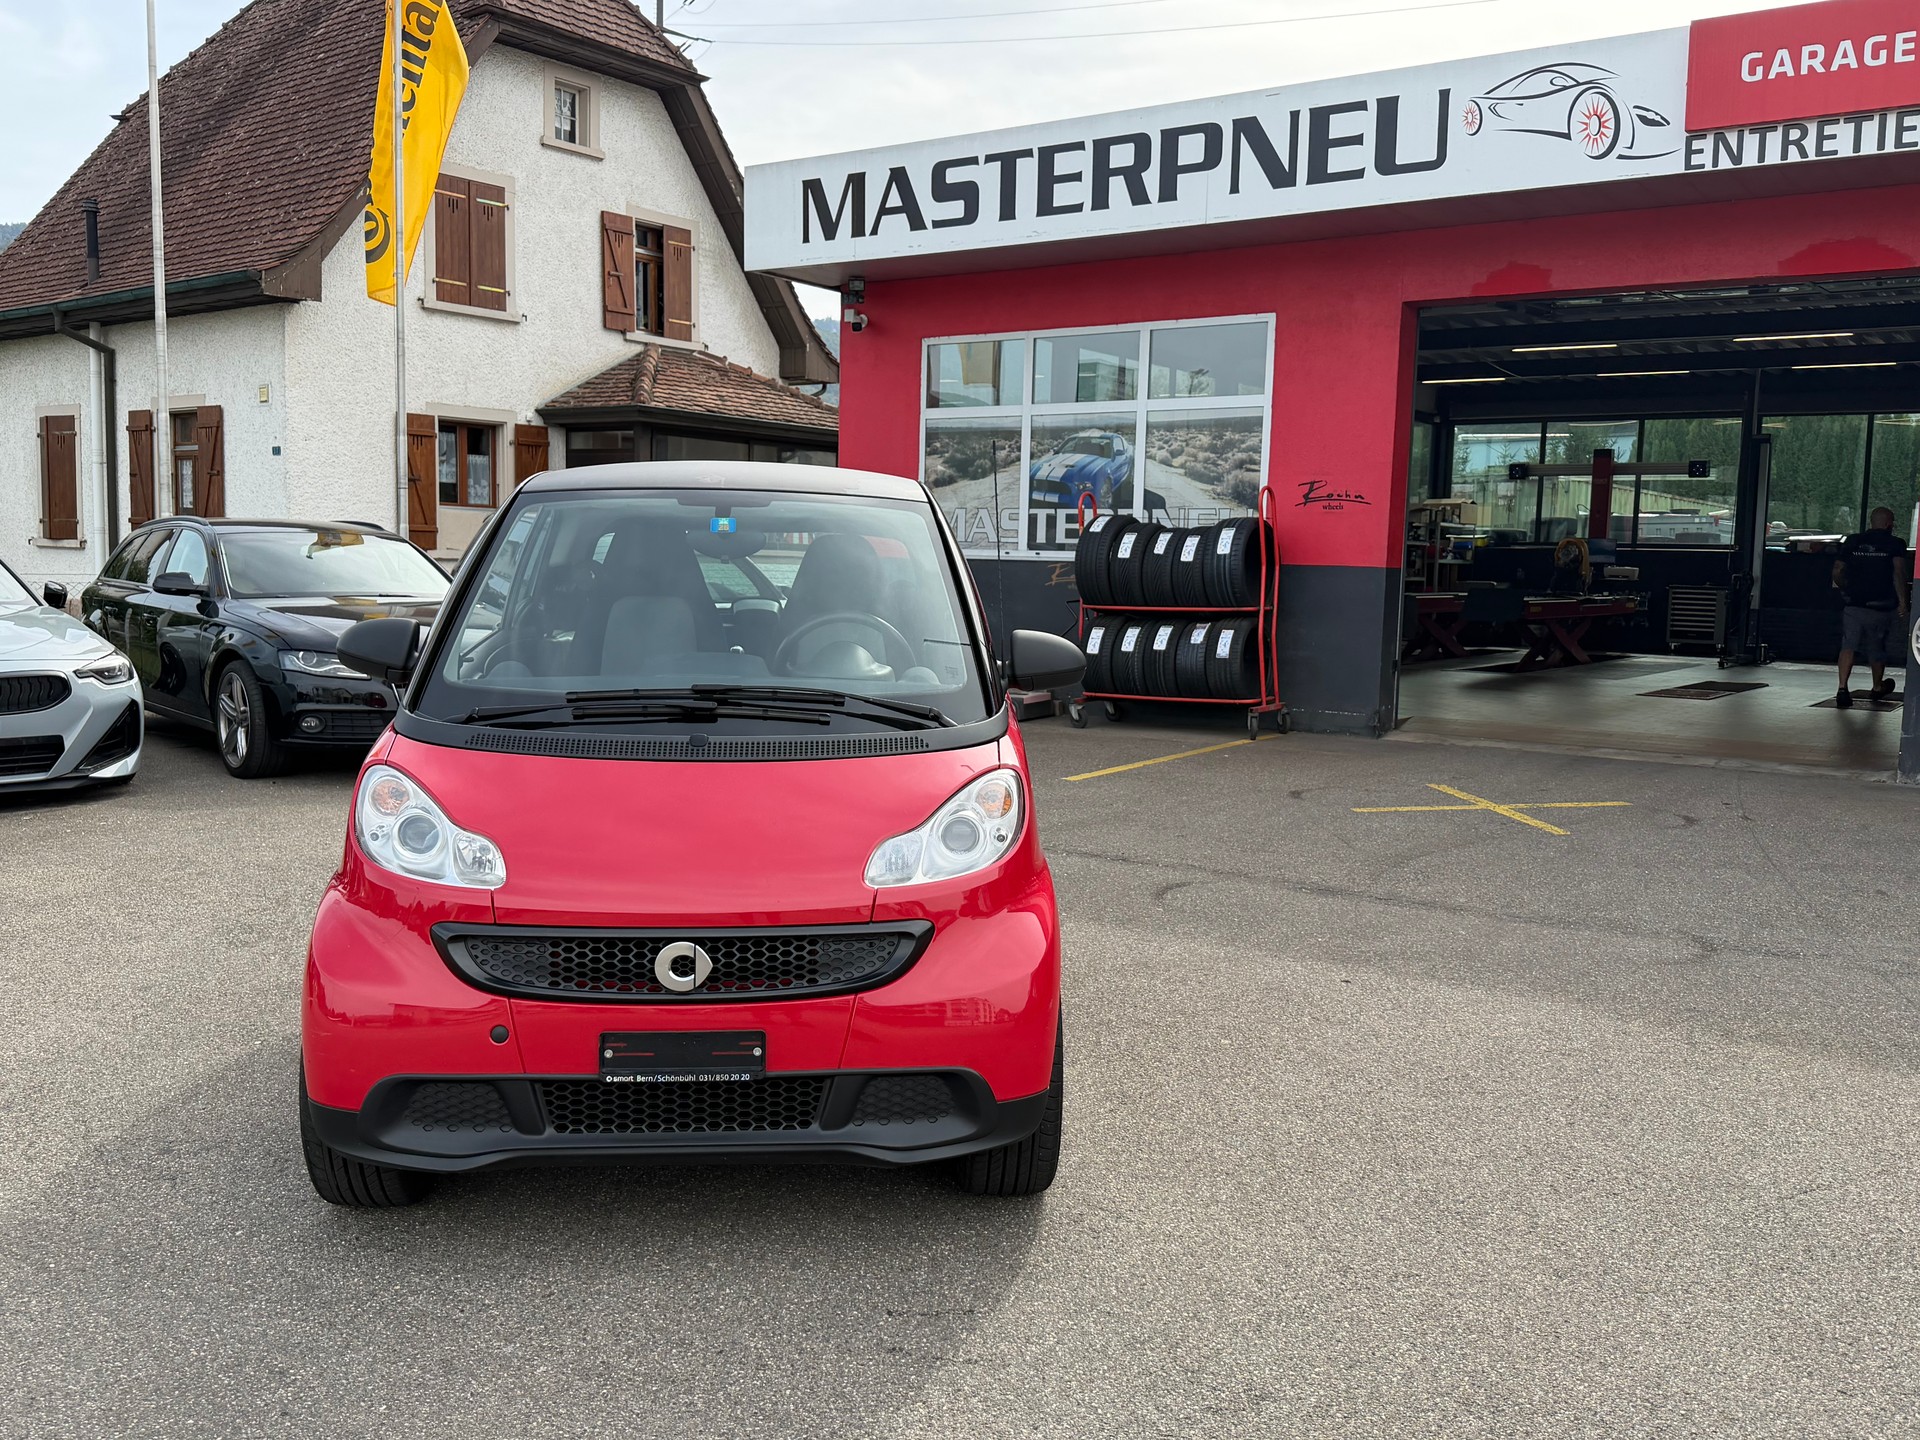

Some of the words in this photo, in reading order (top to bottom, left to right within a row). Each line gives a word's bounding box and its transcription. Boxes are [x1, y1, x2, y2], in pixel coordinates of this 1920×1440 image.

[1740, 30, 1917, 82] GARAGE
[801, 87, 1451, 245] MASTERPNEU
[1684, 109, 1920, 172] ENTRETIE
[636, 1074, 696, 1083] Bern/Schönbühl
[699, 1073, 729, 1082] 031/850
[730, 1073, 740, 1081] 20
[740, 1073, 750, 1081] 20
